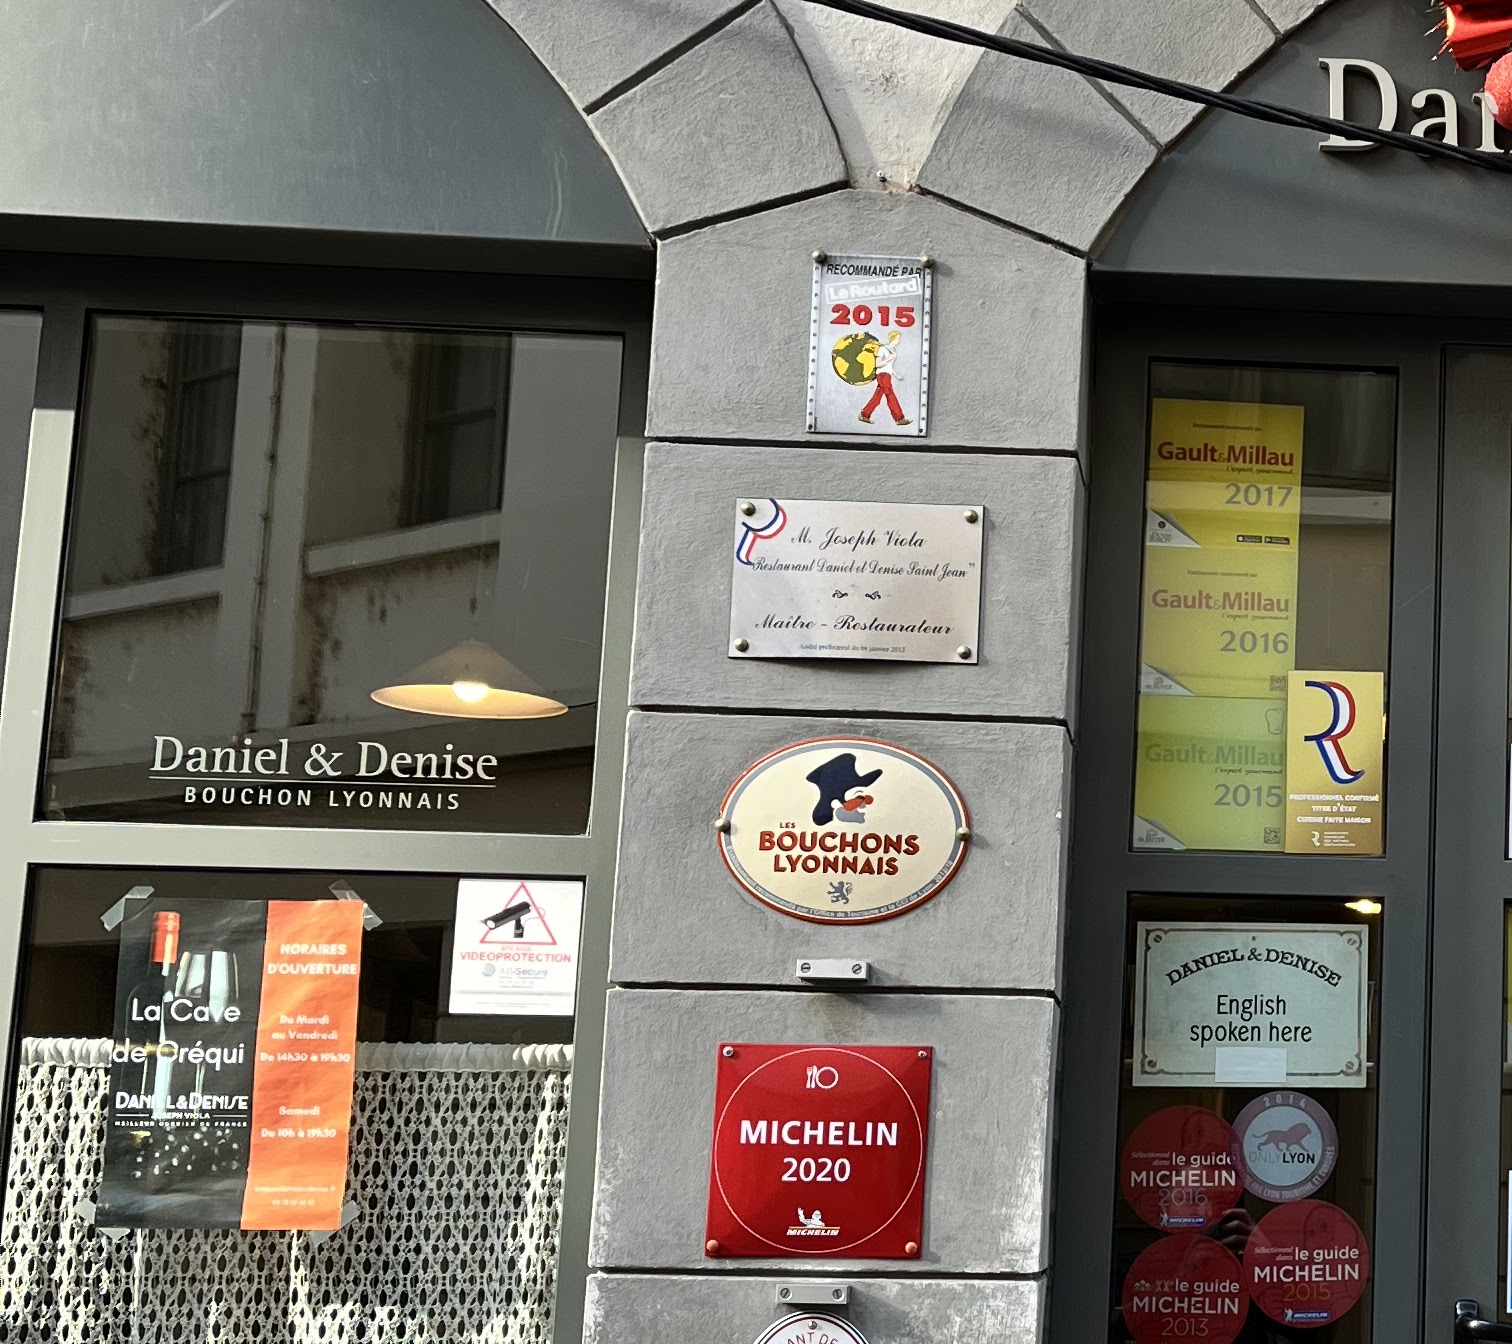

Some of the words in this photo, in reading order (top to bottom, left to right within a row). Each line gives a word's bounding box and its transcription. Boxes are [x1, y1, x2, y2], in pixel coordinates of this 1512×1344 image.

[826, 264, 899, 277] RECOMMANDÉ
[901, 267, 922, 278] PAR
[828, 287, 848, 300] Le
[850, 278, 917, 296] Routard
[830, 304, 915, 327] 2015
[1157, 441, 1294, 467] Gault&Millau
[1225, 483, 1293, 507] 2017
[791, 526, 812, 544] M.
[819, 527, 879, 551] Joseph
[883, 530, 927, 547] Viola
[1152, 589, 1289, 612] Gault&Millau
[755, 614, 817, 630] Maître
[834, 614, 954, 635] Restaurateur
[1220, 630, 1289, 654] 2016
[150, 735, 289, 775] Daniel
[304, 743, 342, 776] &
[355, 741, 498, 780] Denise
[185, 786, 312, 806] BOUCHON
[328, 790, 460, 810] LYONNAIS
[1214, 783, 1283, 807] 2015
[759, 831, 920, 855] BOUCHONS
[774, 855, 899, 875] LYONNAIS
[280, 944, 347, 955] HORAIRES
[459, 952, 571, 962] VIDEOPROTECTION
[267, 963, 357, 974] D'OUVERTURE
[1165, 949, 1244, 985] DANIEL
[1247, 947, 1262, 961] &
[1264, 948, 1342, 987] DENISE
[131, 998, 161, 1021] La
[170, 999, 241, 1022] Cave
[1217, 994, 1287, 1021] English
[272, 1032, 286, 1040] au
[288, 1030, 339, 1040] Vendredi
[1190, 1021, 1261, 1048] spoken
[1269, 1021, 1312, 1042] here
[112, 1038, 147, 1063] de
[279, 1106, 320, 1115] Samedi
[740, 1120, 898, 1146] MICHELIN
[781, 1157, 851, 1182] 2020
[1130, 1170, 1236, 1187] MICHELIN
[1294, 1247, 1309, 1261] le
[1313, 1246, 1359, 1262] guide
[1254, 1264, 1359, 1283] MICHELIN
[1175, 1279, 1189, 1291] le
[1193, 1280, 1240, 1294] guide
[1132, 1296, 1239, 1315] MICHELIN
[1161, 1318, 1209, 1337] 2013
